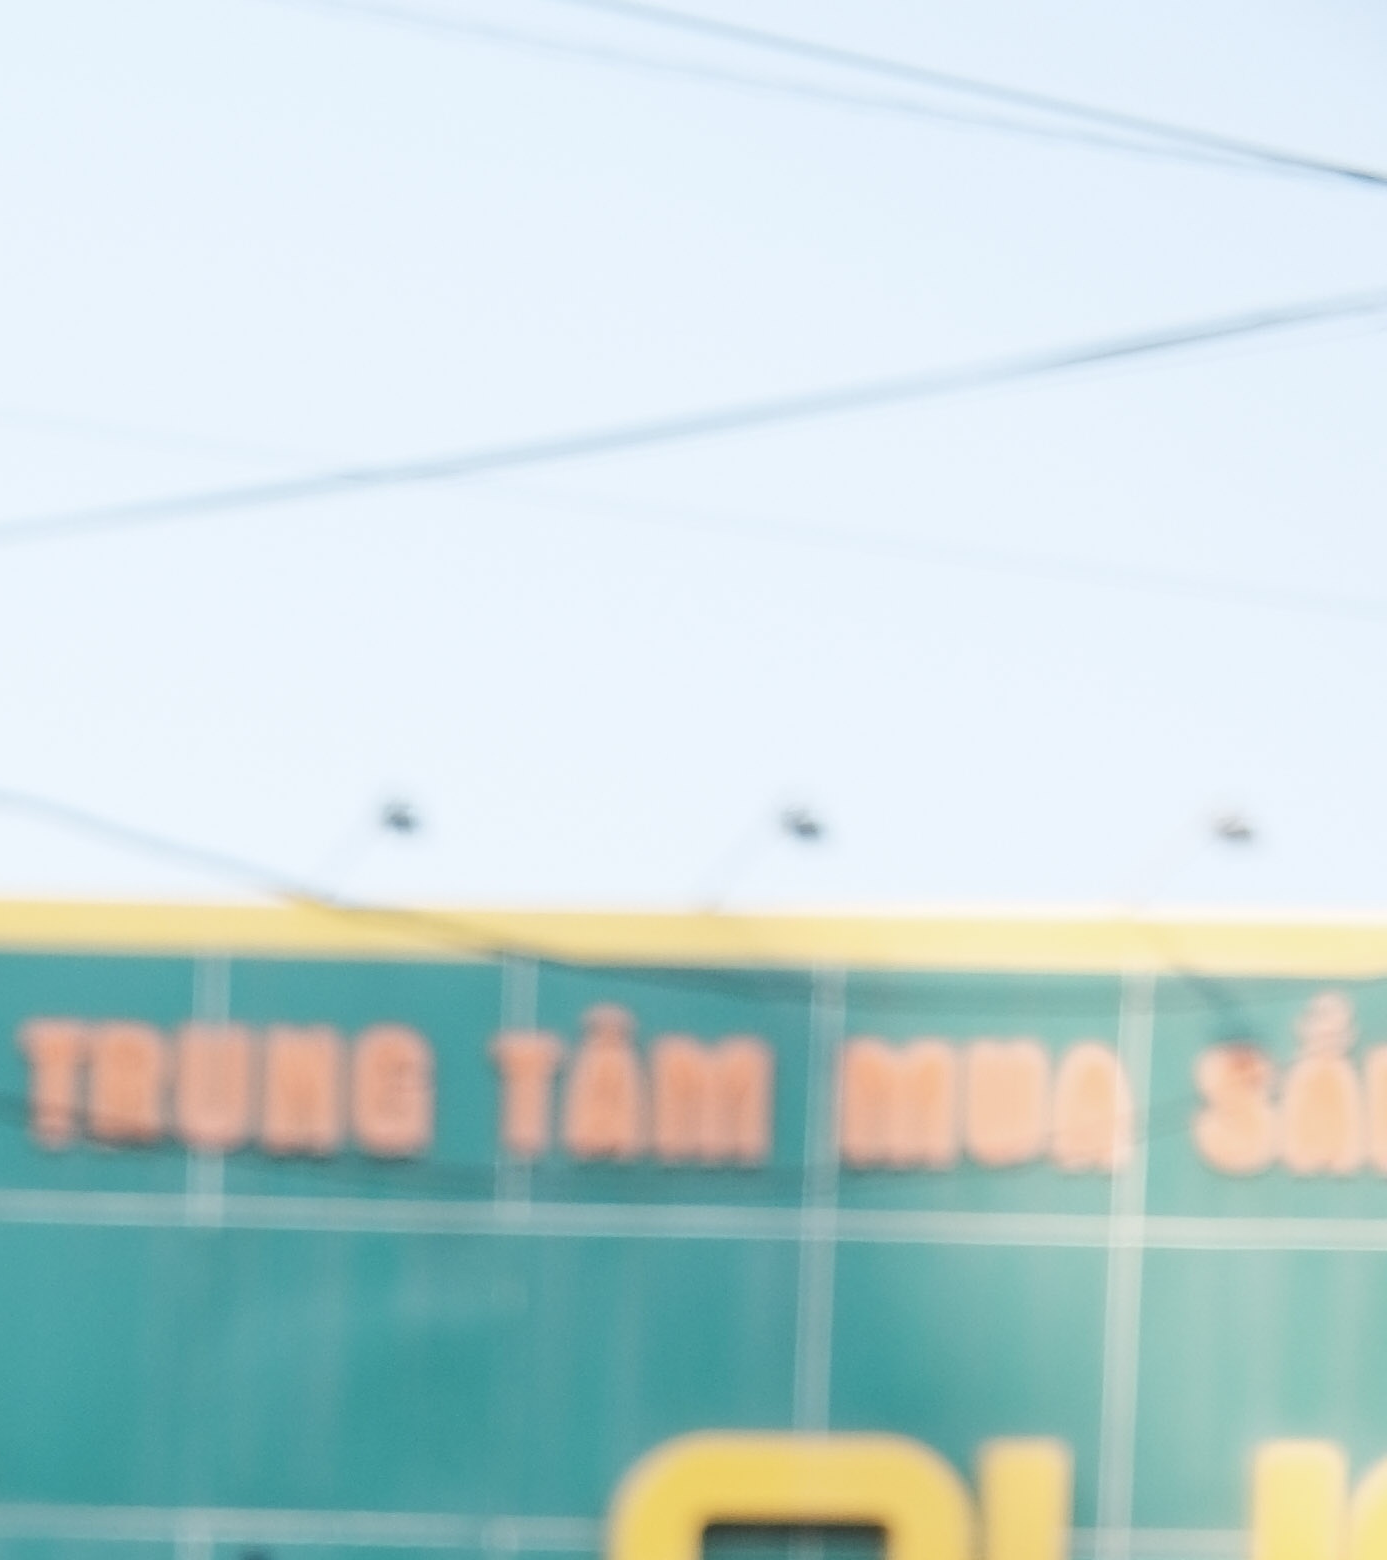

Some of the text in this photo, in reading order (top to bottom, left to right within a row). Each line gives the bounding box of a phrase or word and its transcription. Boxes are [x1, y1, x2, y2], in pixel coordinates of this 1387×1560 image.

[19, 992, 1387, 1178] TRUNG TÂM MUA SẮ
